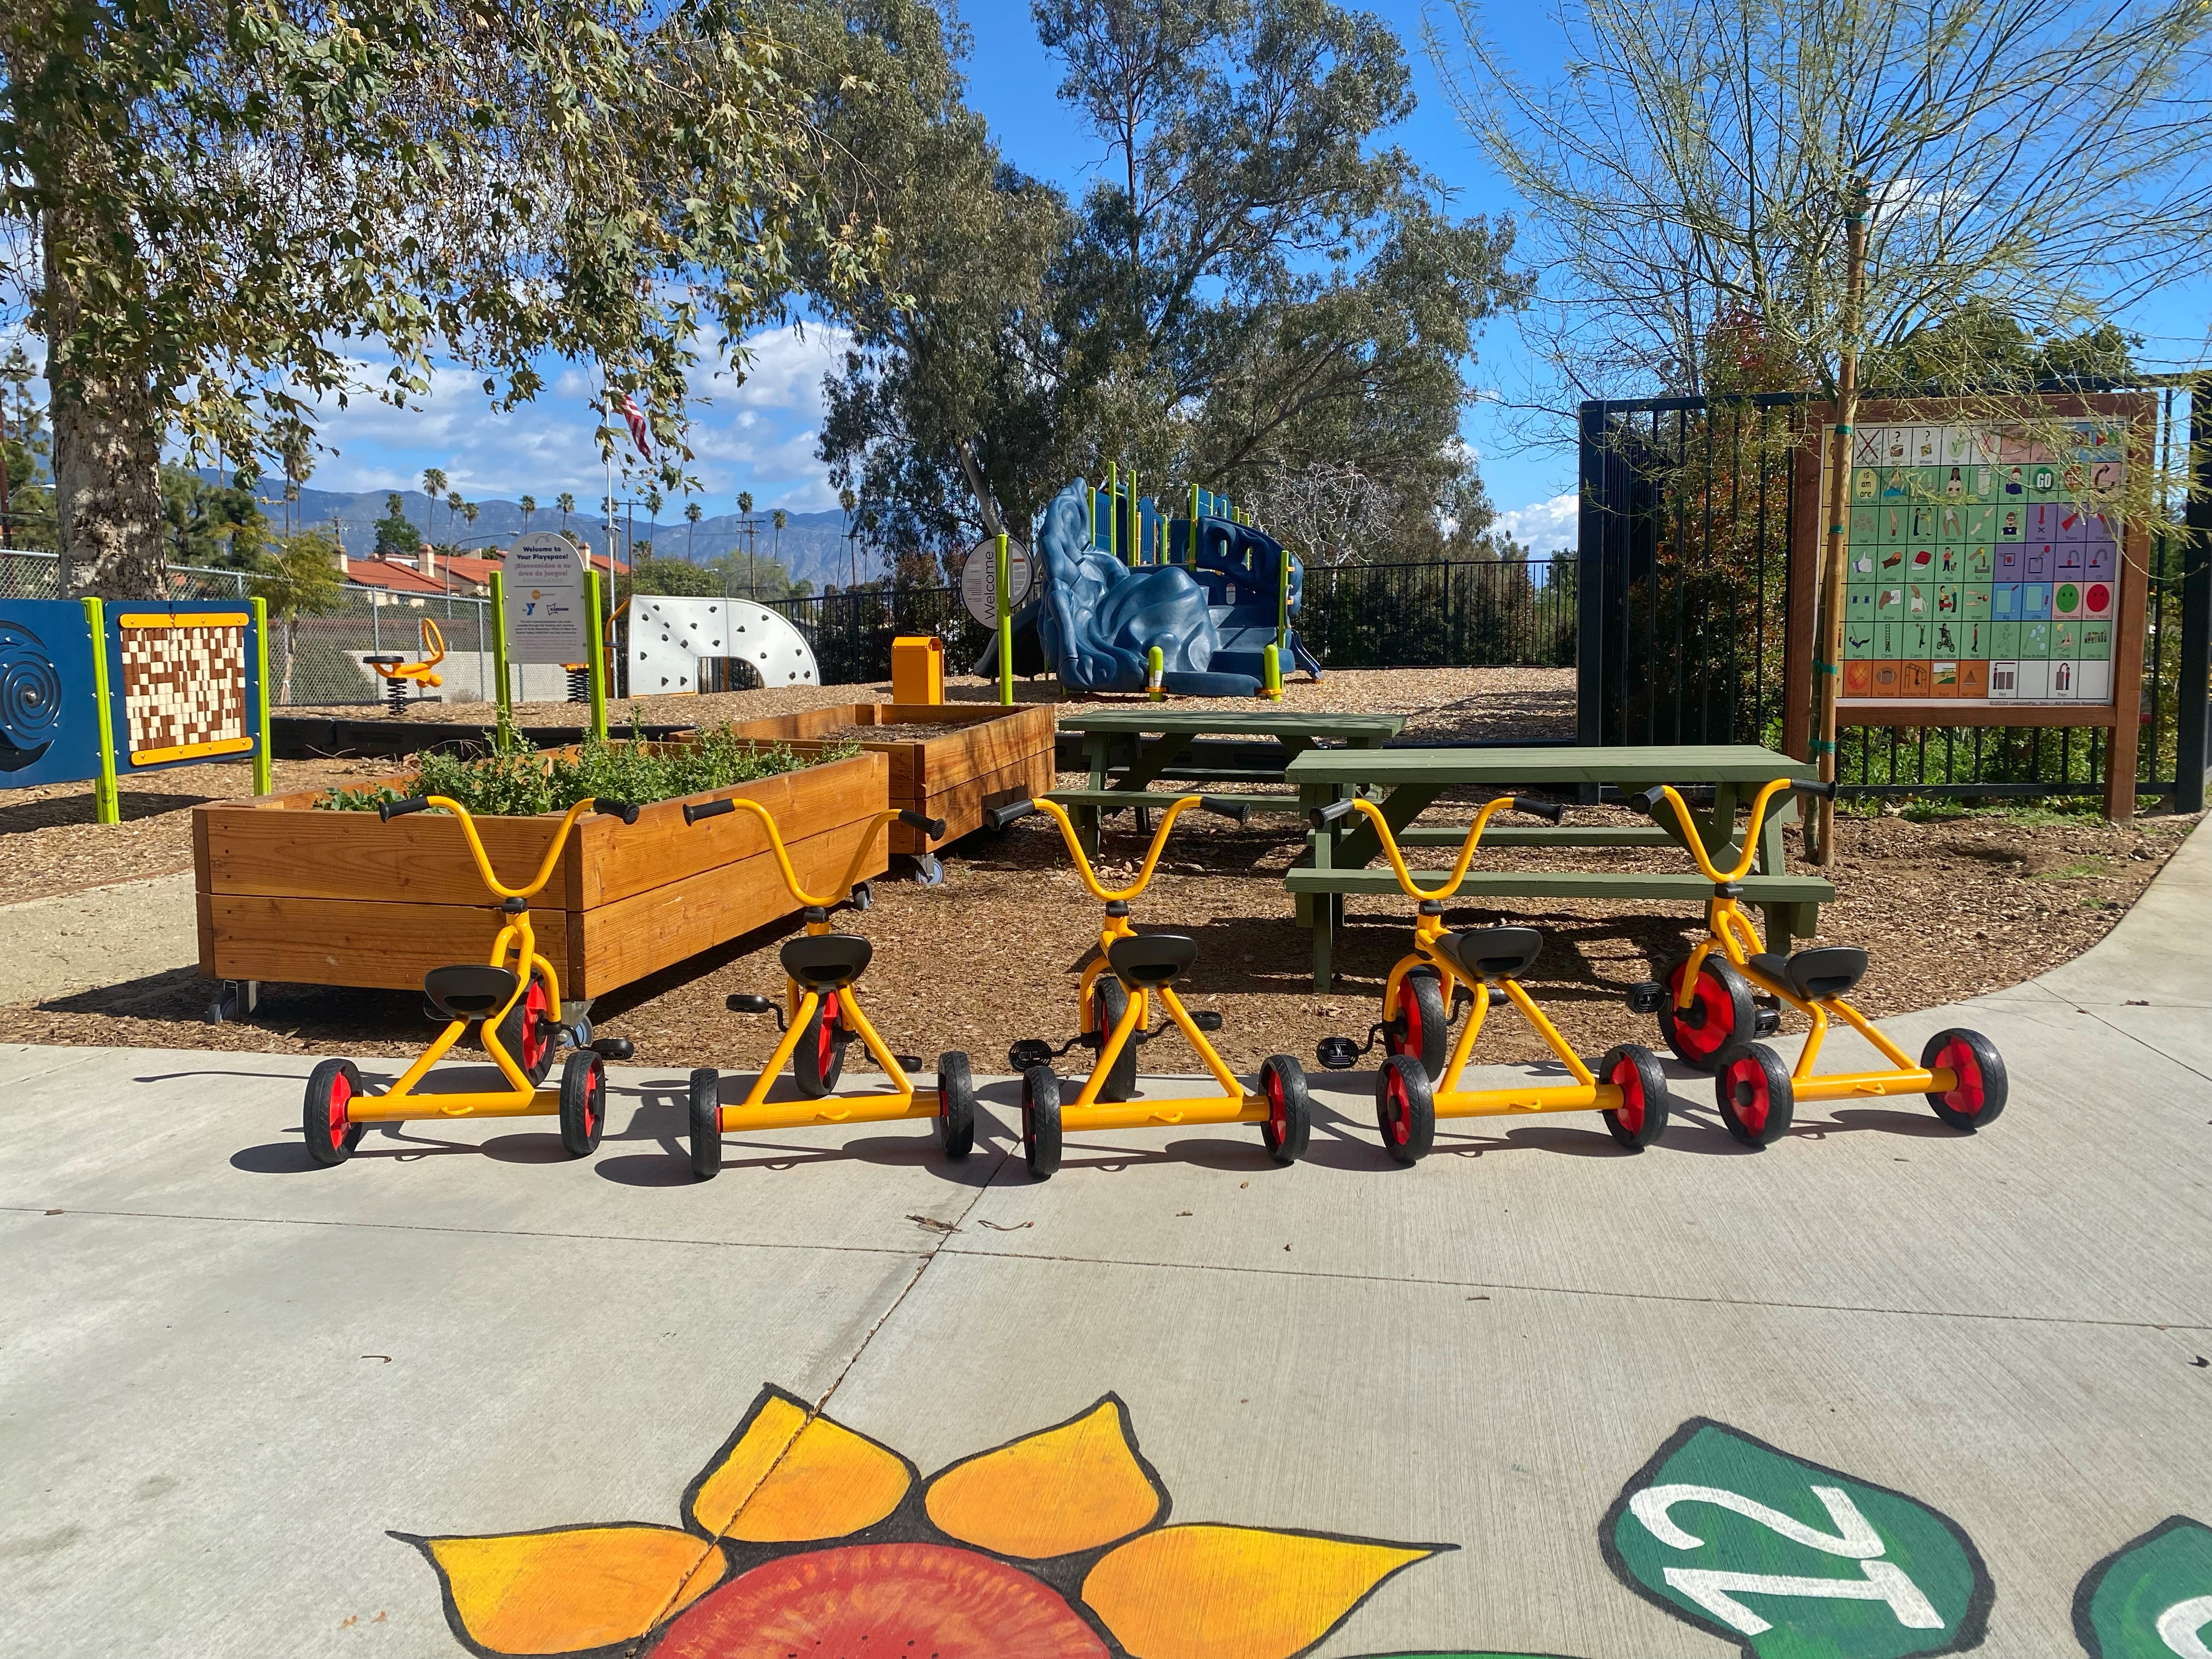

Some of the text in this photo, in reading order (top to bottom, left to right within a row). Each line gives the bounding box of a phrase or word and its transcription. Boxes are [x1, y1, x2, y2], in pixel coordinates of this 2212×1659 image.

[2037, 473, 2052, 488] GO
[984, 551, 996, 620] Welcome
[1629, 1483, 1945, 1636] 12
